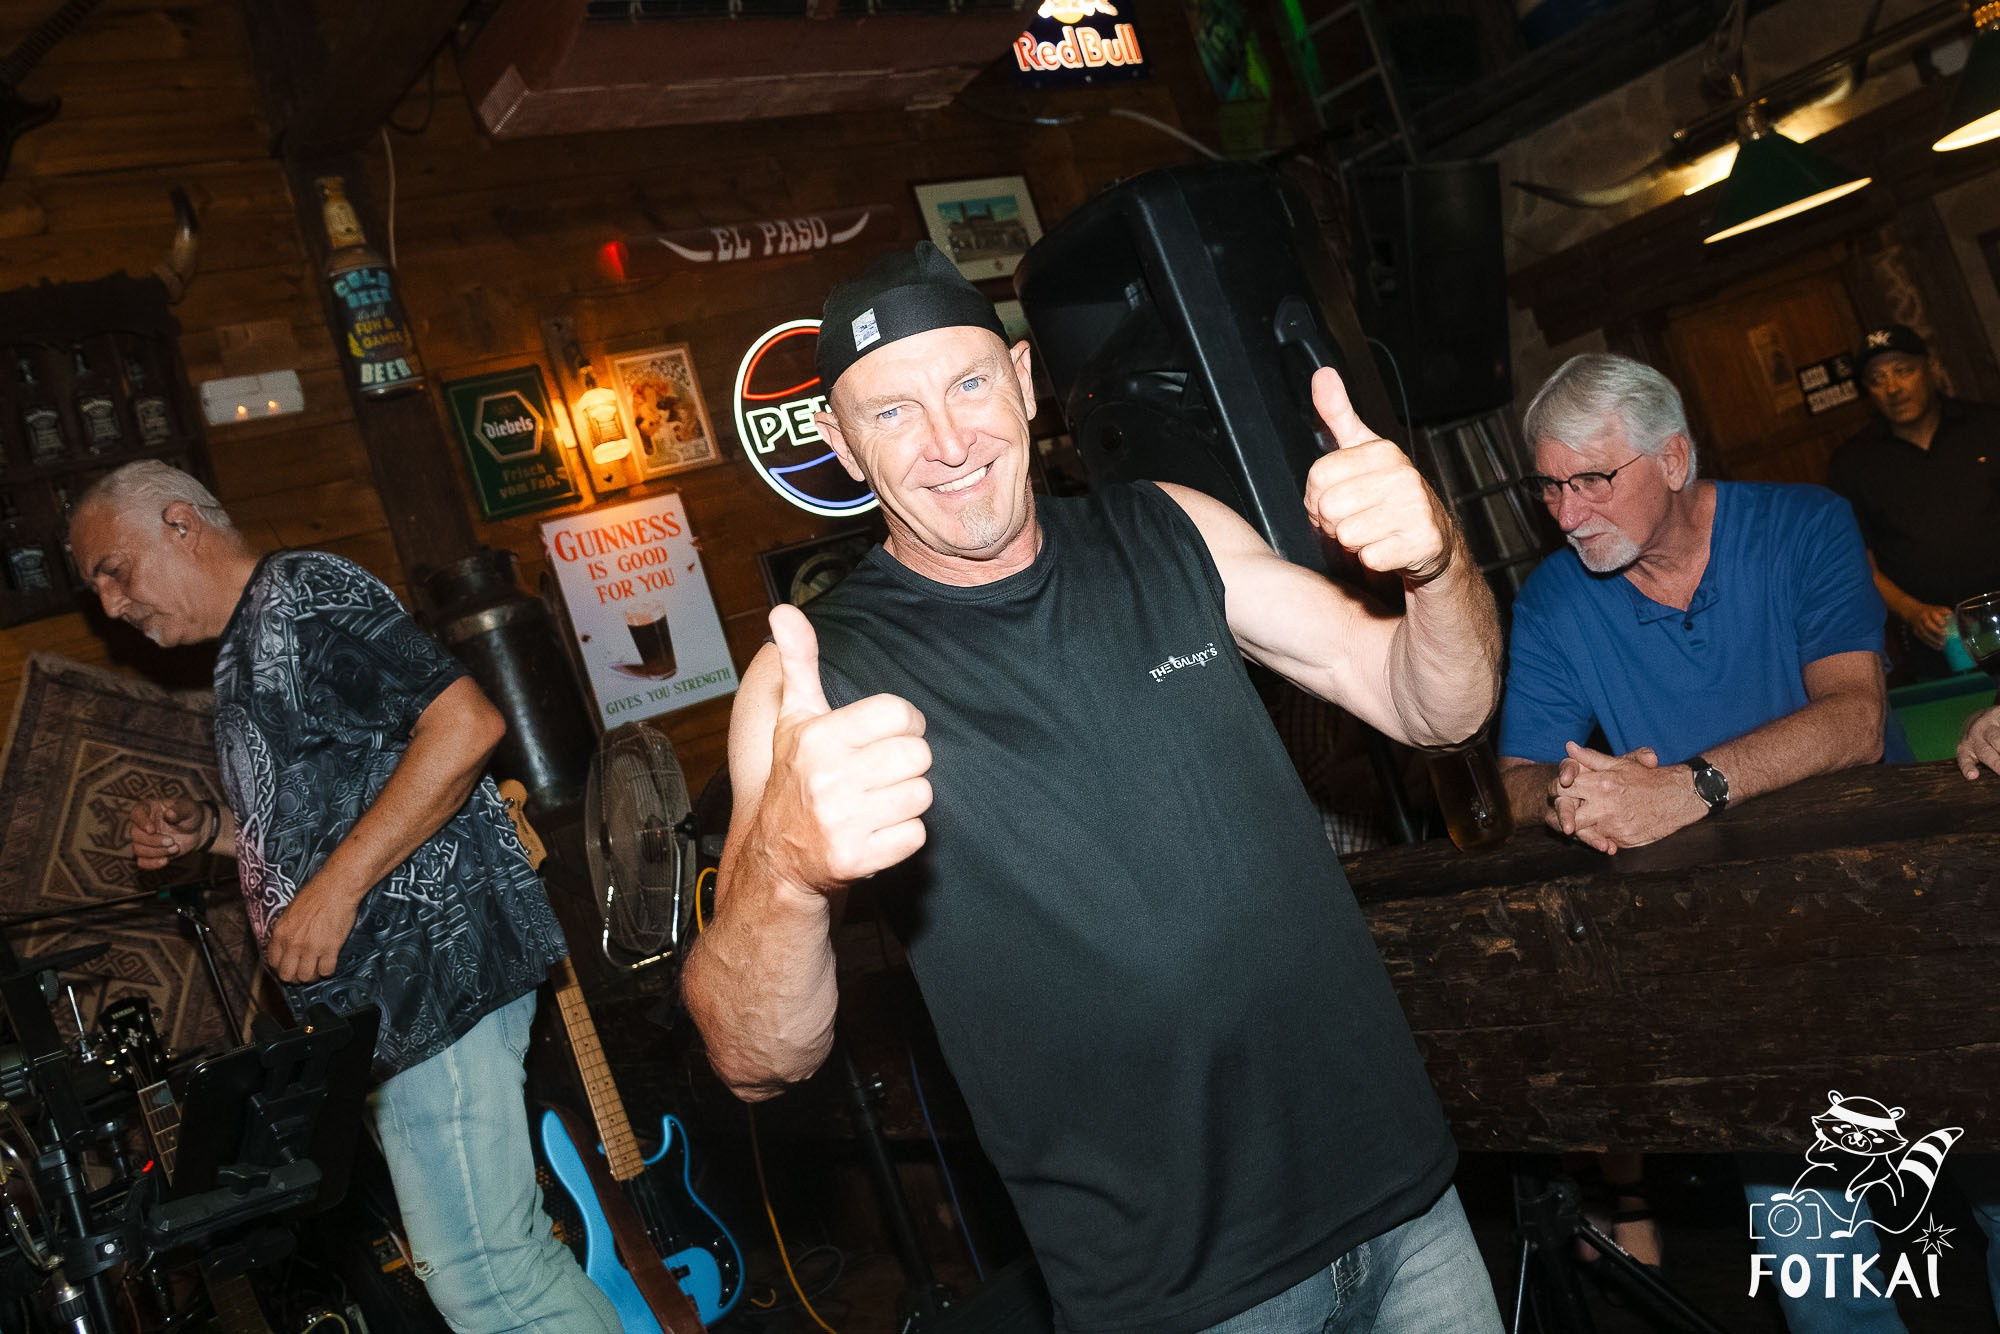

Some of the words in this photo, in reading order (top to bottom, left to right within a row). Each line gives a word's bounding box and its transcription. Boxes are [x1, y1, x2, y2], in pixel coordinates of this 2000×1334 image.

[711, 227, 750, 262] EL
[756, 215, 829, 256] PASO
[333, 268, 391, 298] COLD
[361, 357, 412, 384] BEER
[483, 416, 534, 439] Diebels
[746, 395, 833, 454] PE
[554, 511, 682, 563] GUINNESS
[587, 562, 608, 581] IS
[617, 546, 669, 573] GOOD
[596, 578, 635, 606] FOR
[637, 567, 676, 593] YOU
[1149, 663, 1173, 679] THE
[1173, 647, 1218, 669] GALAXY'S
[605, 694, 643, 716] GIVES
[647, 686, 671, 703] YOU
[673, 667, 732, 694] STRENGTH
